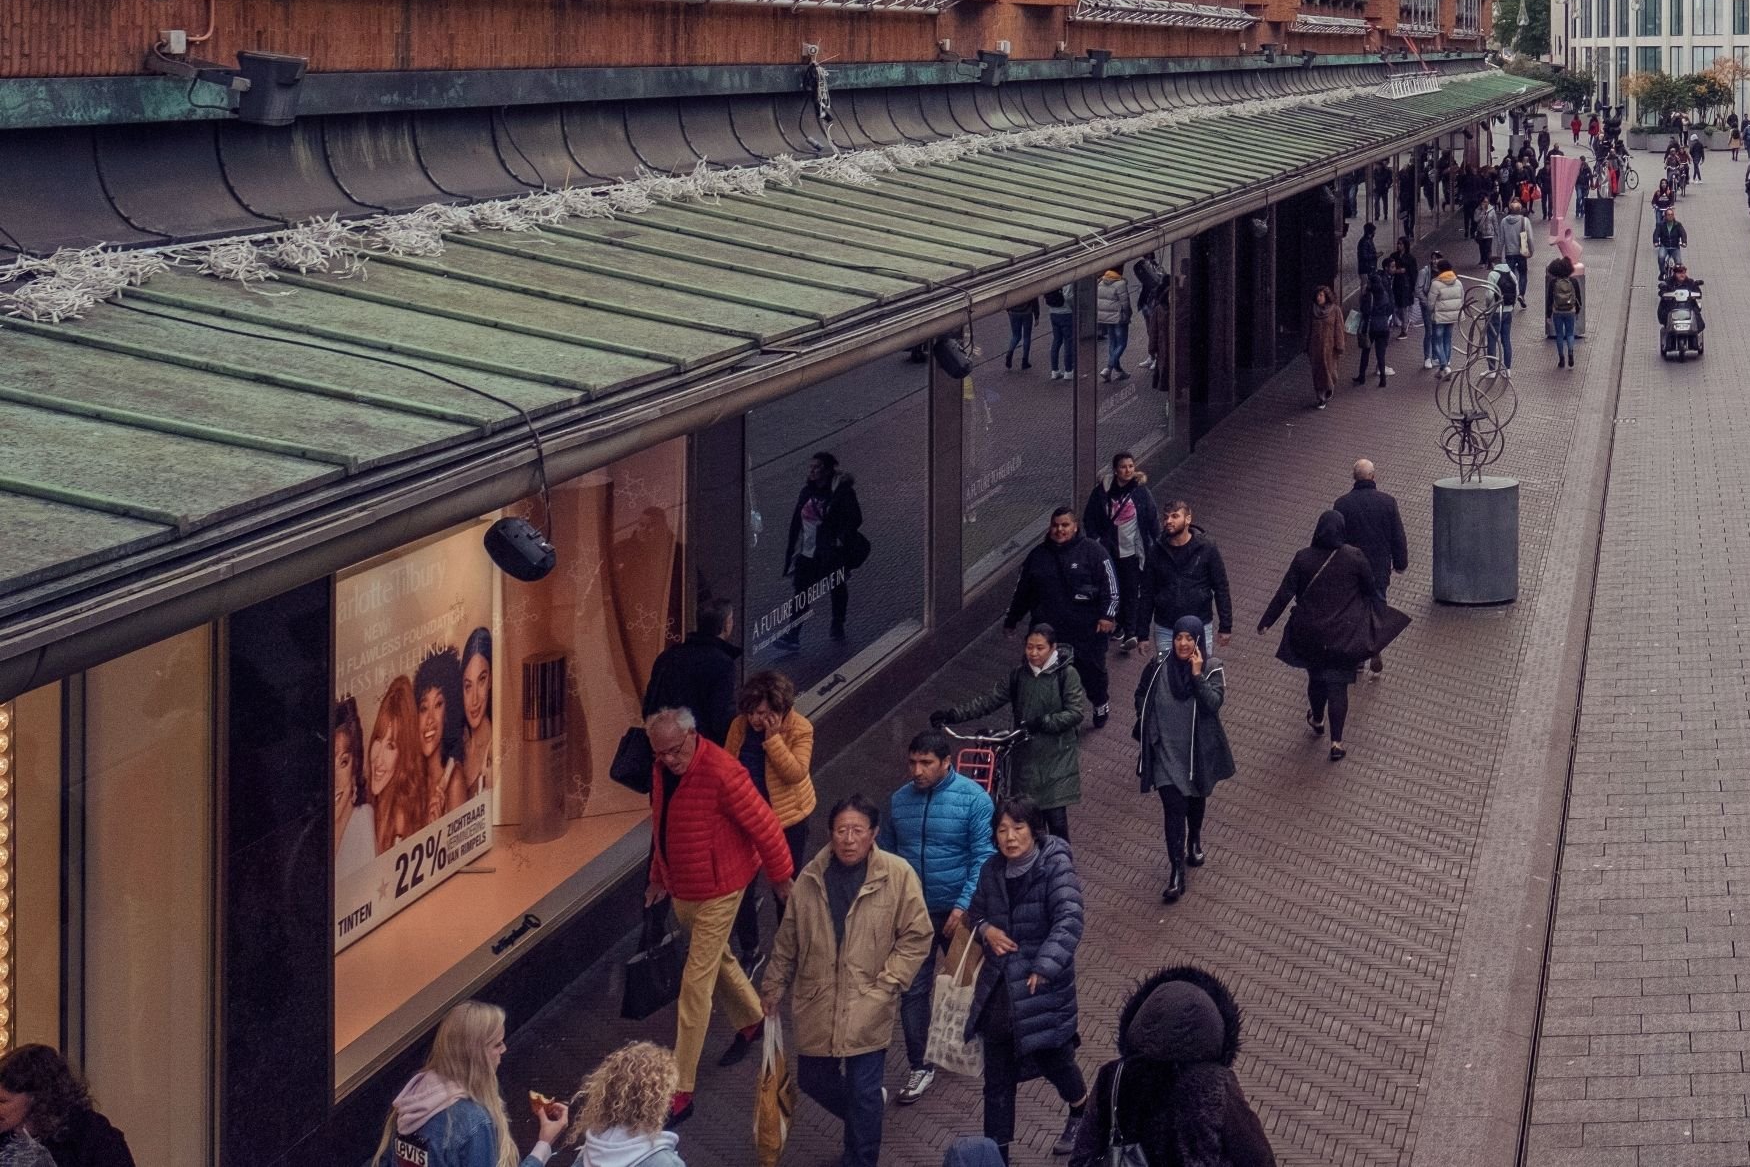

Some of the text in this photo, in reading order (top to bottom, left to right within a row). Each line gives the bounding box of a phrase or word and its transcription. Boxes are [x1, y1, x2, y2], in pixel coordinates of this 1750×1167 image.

[752, 620, 759, 641] A
[760, 598, 793, 635] FUTURE
[794, 591, 806, 612] TO
[807, 572, 836, 605] BELIEVE
[836, 565, 845, 586] IN
[346, 635, 401, 674] FLAWLESS
[398, 632, 449, 674] FEELING!
[447, 803, 486, 838] ZICHTBAAR
[394, 829, 447, 899] 22%
[447, 831, 487, 866] VAN RIMPELS
[337, 900, 372, 938] TINTEN
